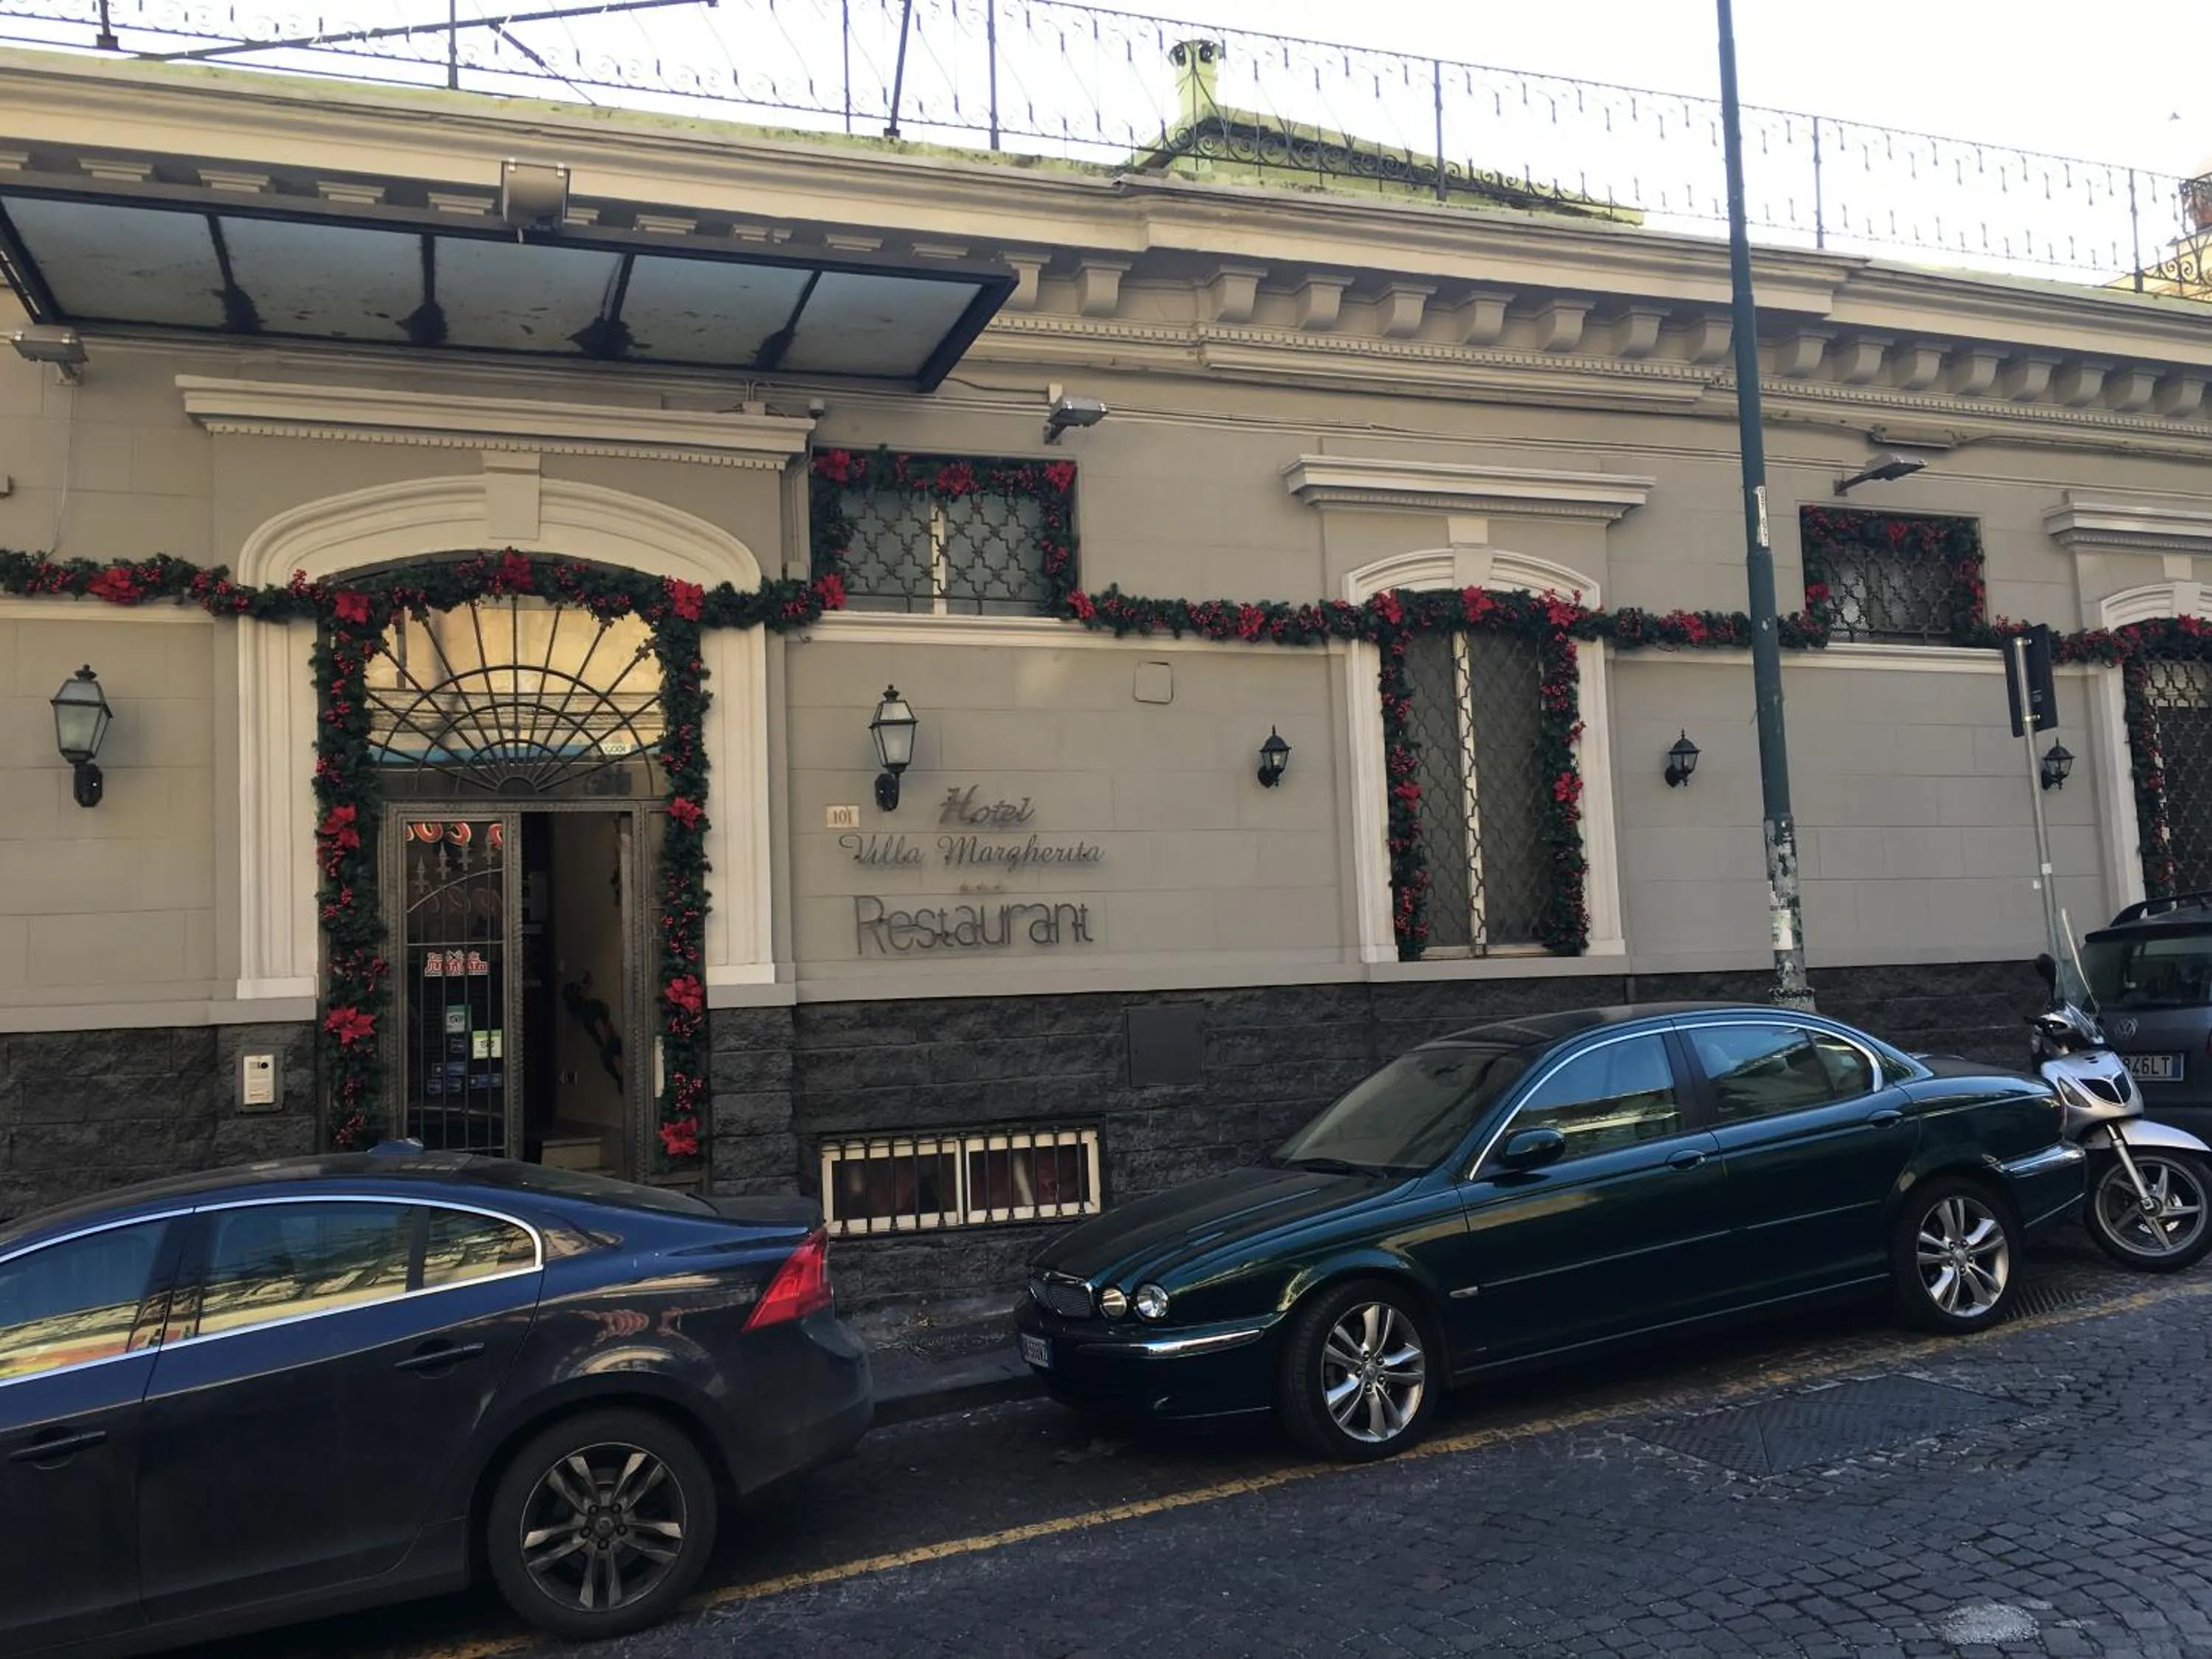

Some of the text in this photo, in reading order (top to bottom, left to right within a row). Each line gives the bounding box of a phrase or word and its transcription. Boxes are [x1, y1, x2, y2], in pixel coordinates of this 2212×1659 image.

[832, 808, 853, 825] 101
[939, 785, 1035, 825] Hotel
[839, 834, 1105, 873] Villa Margherita
[854, 895, 1095, 956] Restaurant
